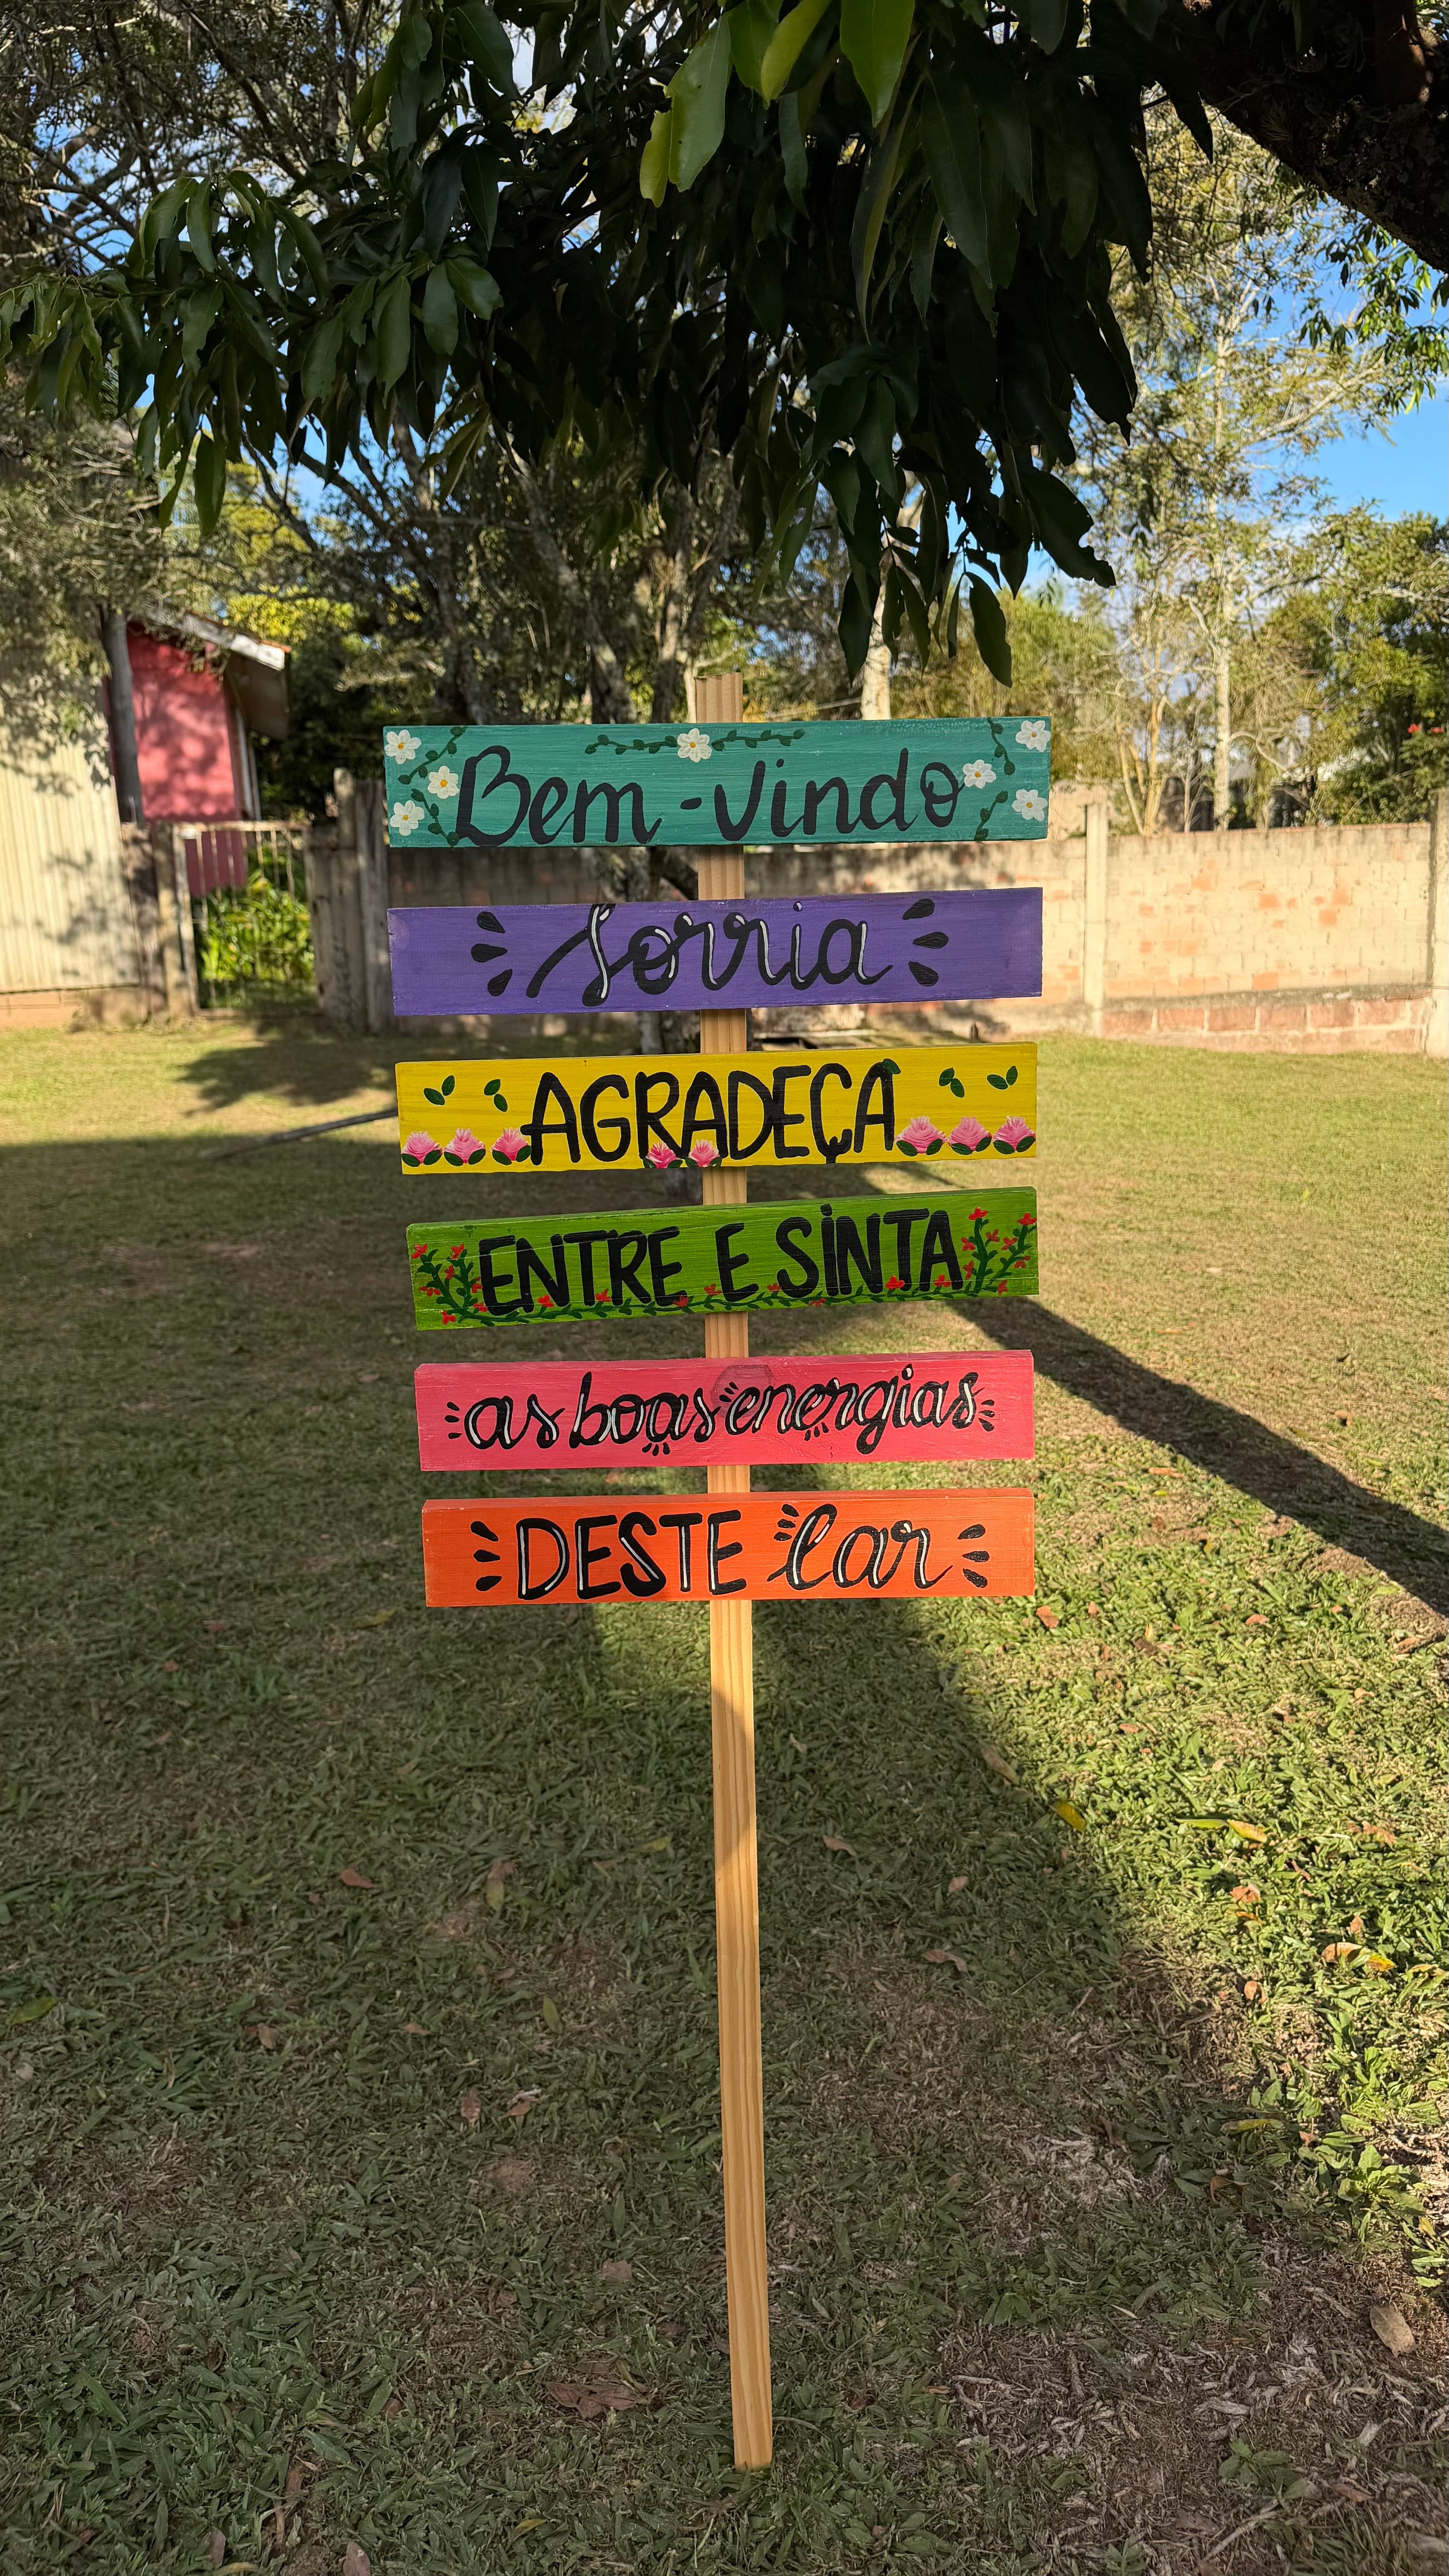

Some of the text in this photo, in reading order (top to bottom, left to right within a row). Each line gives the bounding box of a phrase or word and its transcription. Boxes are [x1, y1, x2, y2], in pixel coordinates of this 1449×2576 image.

[478, 1225, 689, 1316] ENTRE
[717, 1222, 759, 1303] E
[464, 1363, 986, 1455] as boas energias
[515, 1503, 954, 1601] DESTE lar
